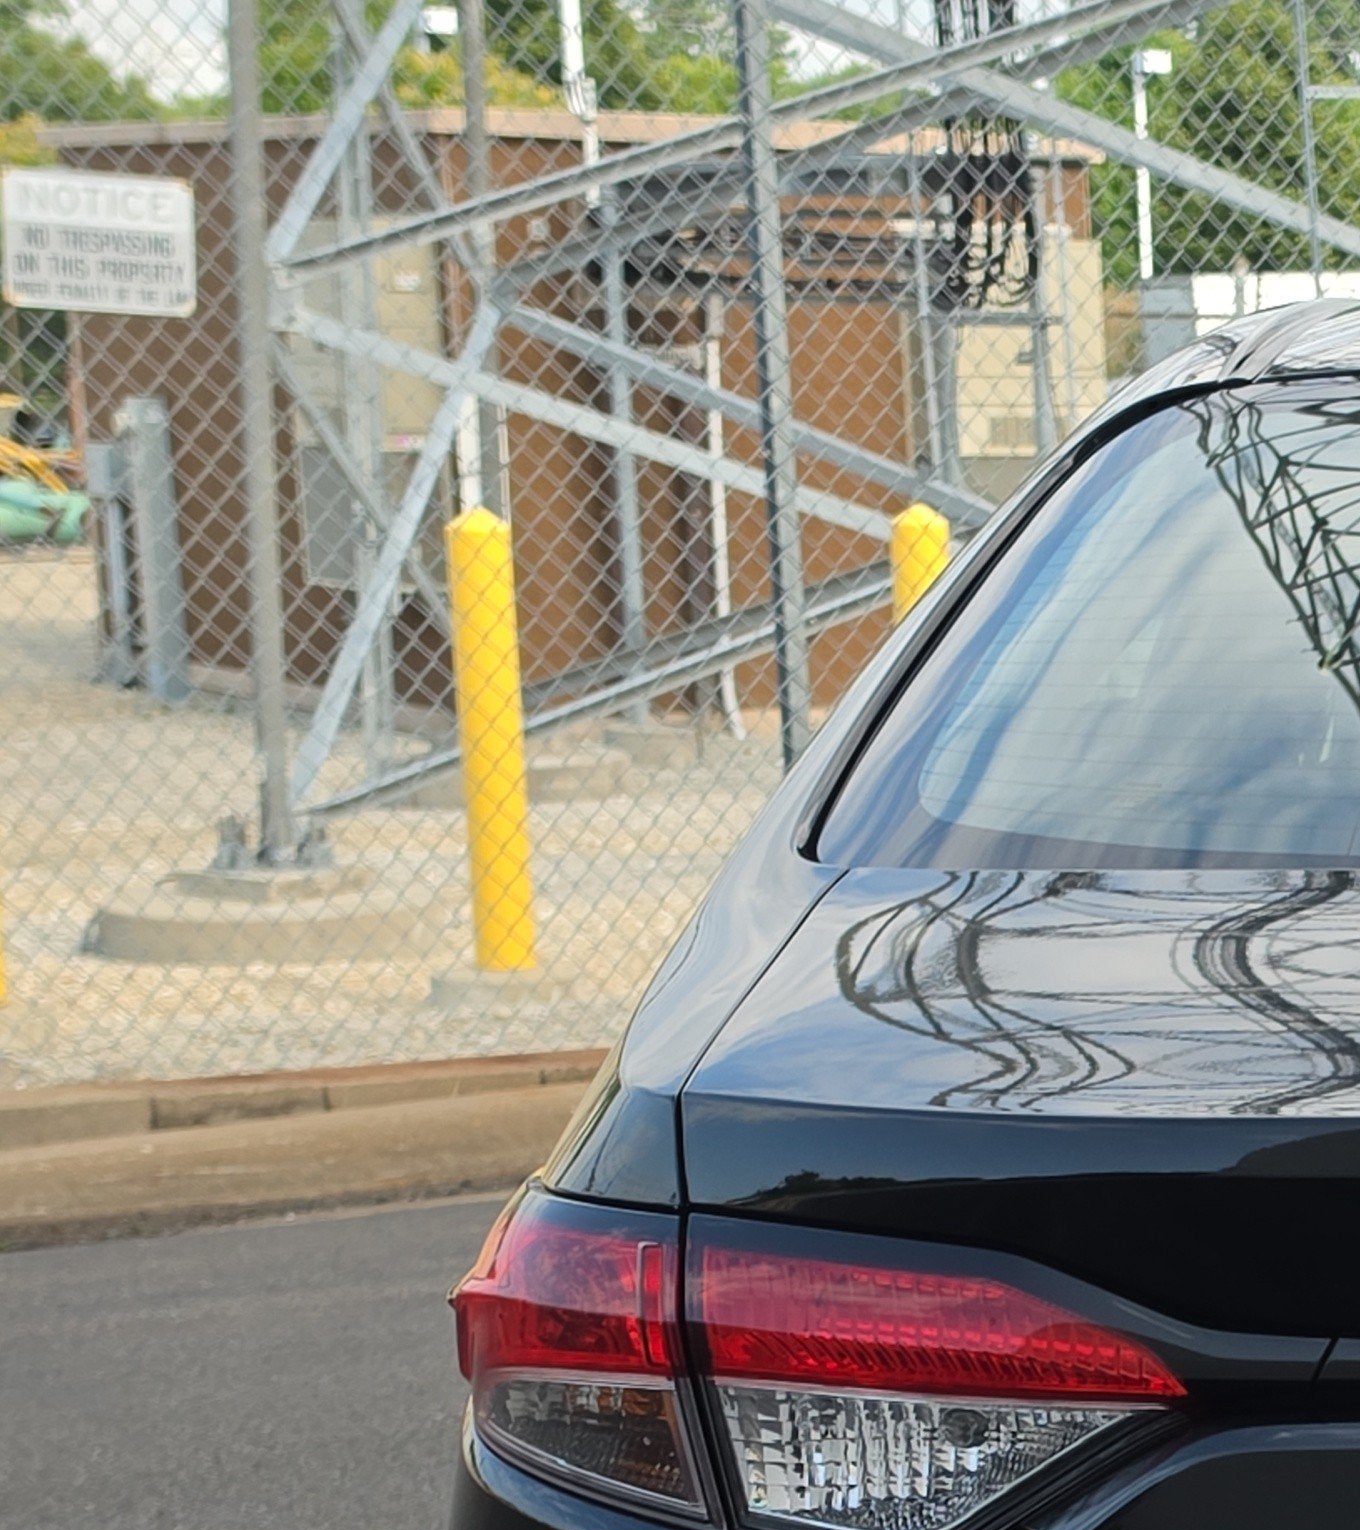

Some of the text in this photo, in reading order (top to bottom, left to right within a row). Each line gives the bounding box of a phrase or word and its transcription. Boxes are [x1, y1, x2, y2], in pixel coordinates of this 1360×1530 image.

[17, 182, 178, 222] NOTICE
[23, 225, 174, 257] NO TRESPASSING
[14, 252, 186, 285] ON THIS PROPERTY
